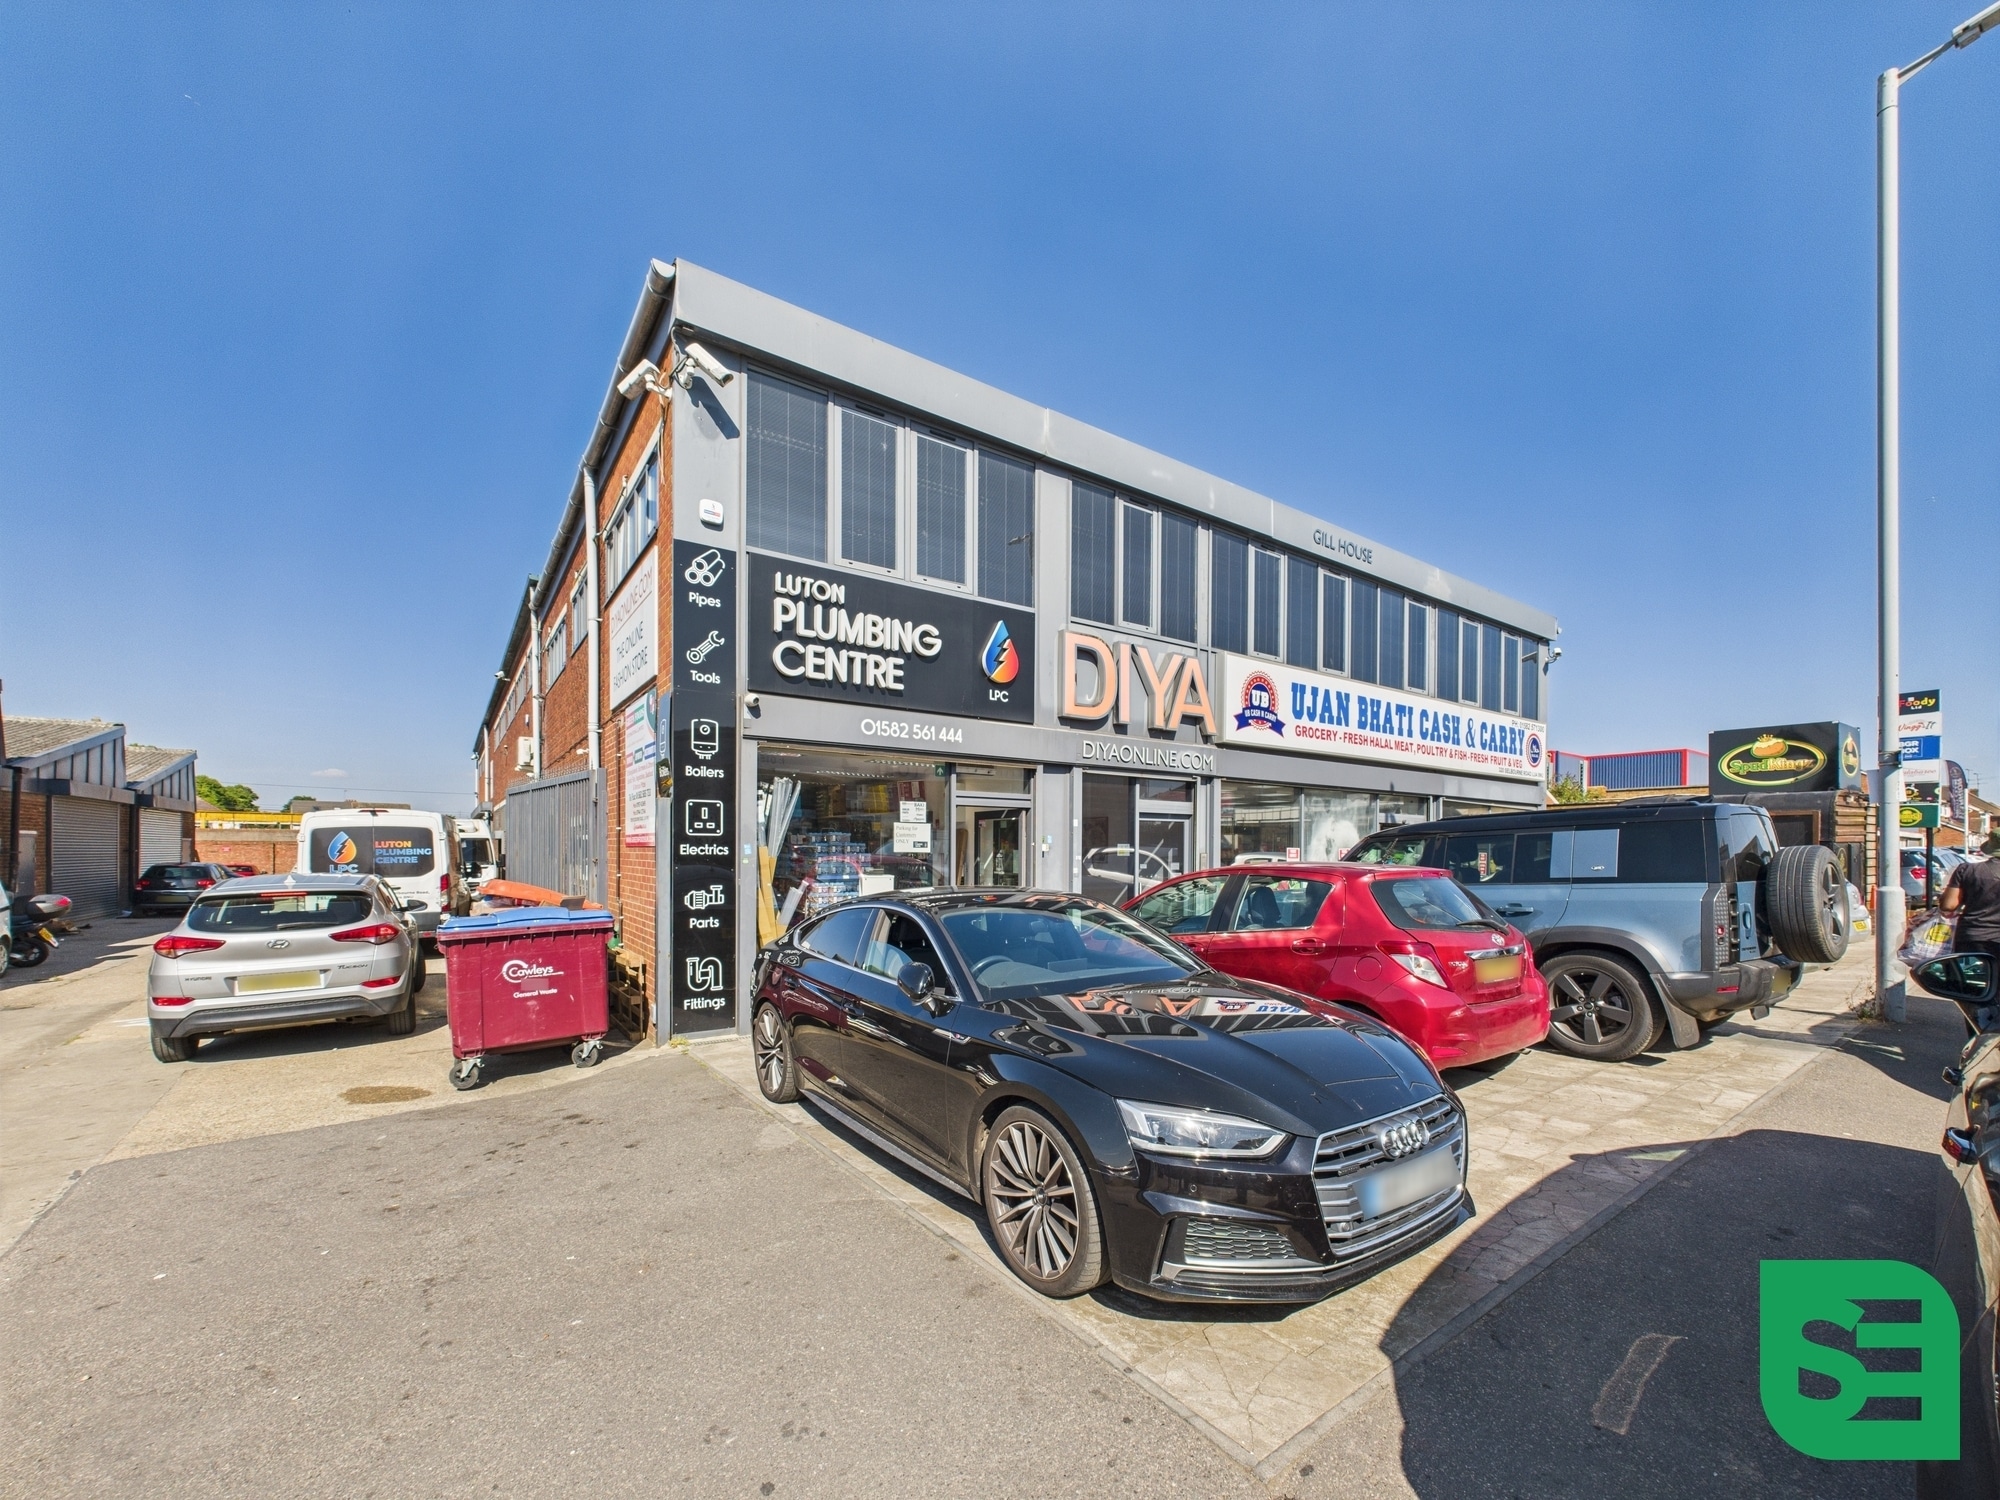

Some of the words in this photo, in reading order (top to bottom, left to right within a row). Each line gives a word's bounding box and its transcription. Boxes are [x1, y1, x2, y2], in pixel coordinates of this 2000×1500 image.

[1313, 529, 1335, 551] GILL
[1338, 538, 1373, 564] HOUSE
[774, 571, 845, 605] LUTON
[689, 592, 721, 608] Pipes
[773, 597, 942, 657] PLUMBING
[625, 620, 644, 653] ONLINE
[613, 662, 632, 690] FASHION
[632, 646, 648, 675] STORE
[772, 640, 904, 691] CENTRE
[690, 670, 720, 684] Tools
[1058, 630, 1217, 736] DIYA
[989, 689, 1009, 703] LPC
[1252, 689, 1269, 708] UB
[1251, 709, 1260, 717] CASH
[1291, 682, 1350, 727] UJAN
[1357, 695, 1414, 738] BHATI
[1419, 709, 1461, 746] CASH
[1465, 718, 1476, 748] &
[1480, 722, 1525, 756] CARRY
[861, 718, 909, 739] 01582
[913, 722, 936, 741] 561
[939, 726, 963, 744] 444
[1295, 725, 1338, 741] GROCERY
[1343, 732, 1368, 746] FRESH
[1370, 736, 1393, 750] HALAL
[1394, 741, 1416, 755] MEAT,
[1417, 743, 1447, 758] POULTRY
[1490, 755, 1507, 766] FRUIT
[1513, 759, 1523, 769] VEG
[1082, 740, 1214, 772] DIYAONLINE.COM
[685, 765, 724, 778] Boilers
[375, 840, 412, 848] LUTON
[375, 848, 432, 856] PLUMBING
[680, 844, 729, 856] Electrics
[375, 856, 418, 864] CENTRE
[329, 864, 358, 874] LPC
[689, 918, 719, 929] Parts
[513, 990, 539, 998] General
[684, 996, 726, 1011] Fittings
